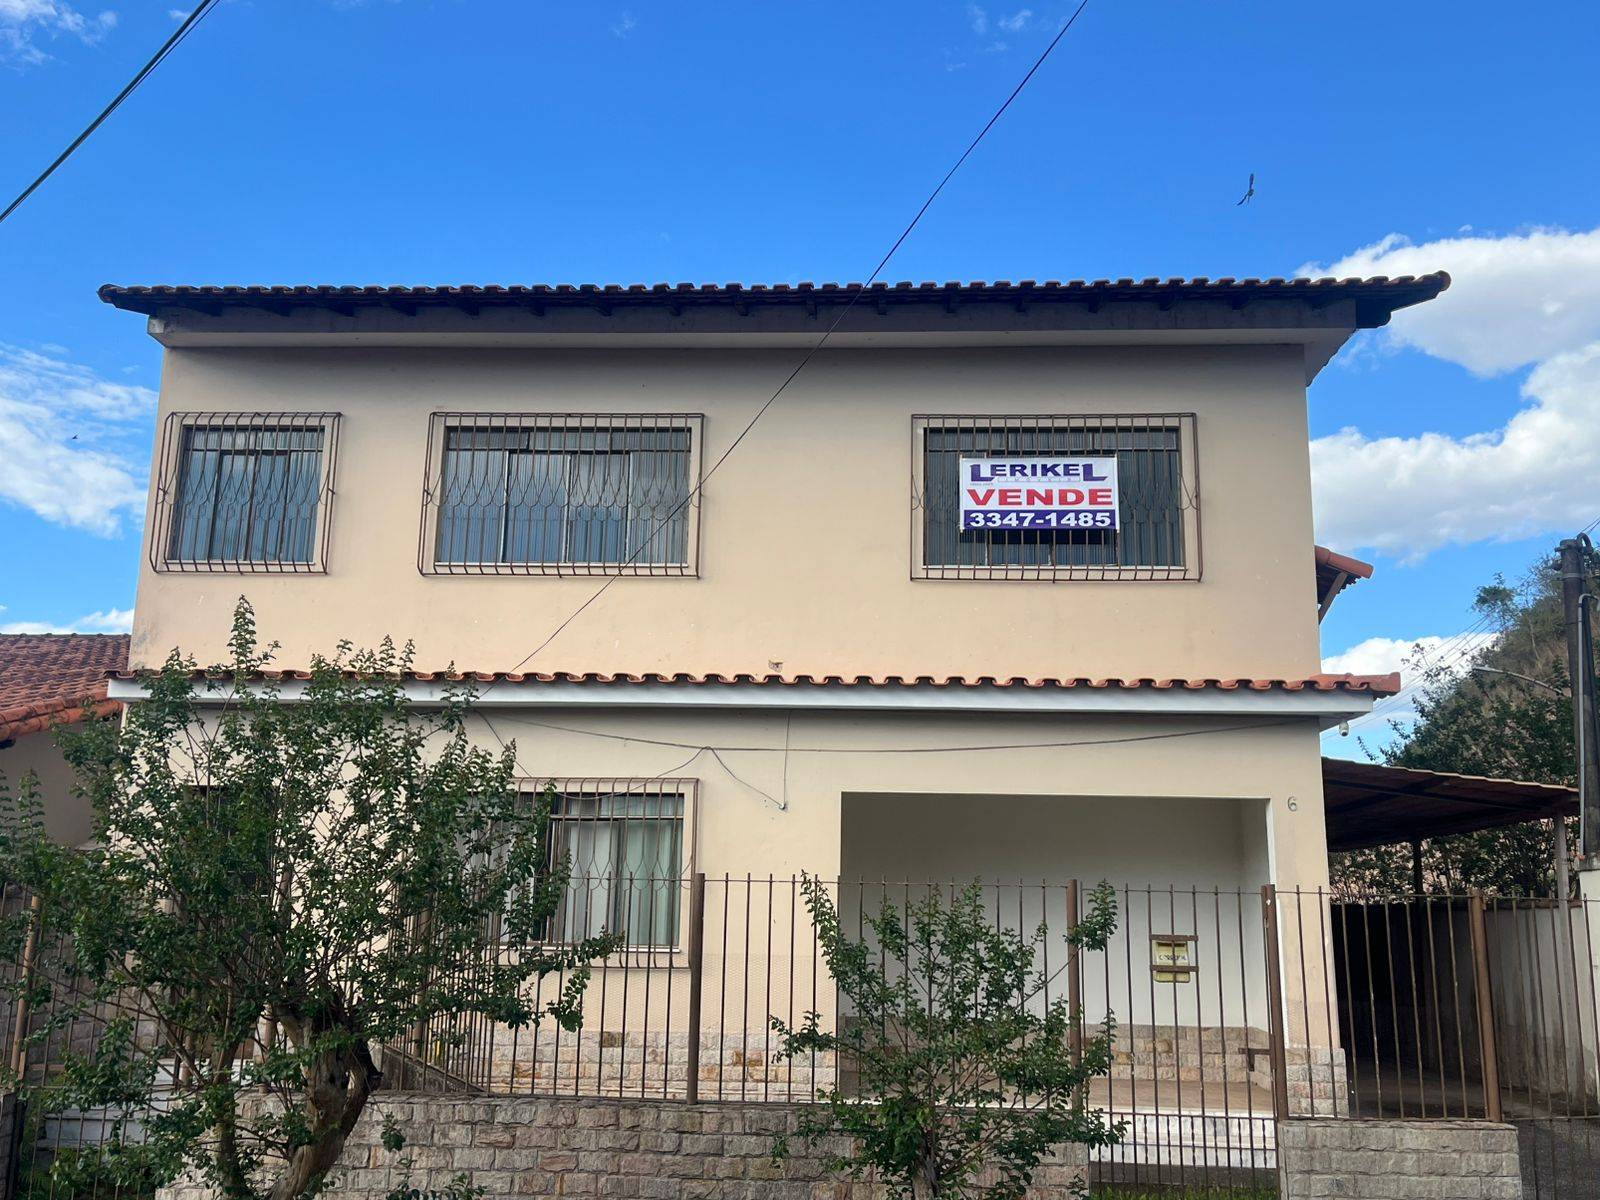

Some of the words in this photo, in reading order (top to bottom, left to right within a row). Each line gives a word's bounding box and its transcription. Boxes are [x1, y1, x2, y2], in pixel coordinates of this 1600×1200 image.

[970, 463, 1108, 482] LERIKEL
[967, 488, 1113, 506] VENDE
[969, 512, 1111, 527] 3347-1485
[1288, 796, 1297, 812] 6
